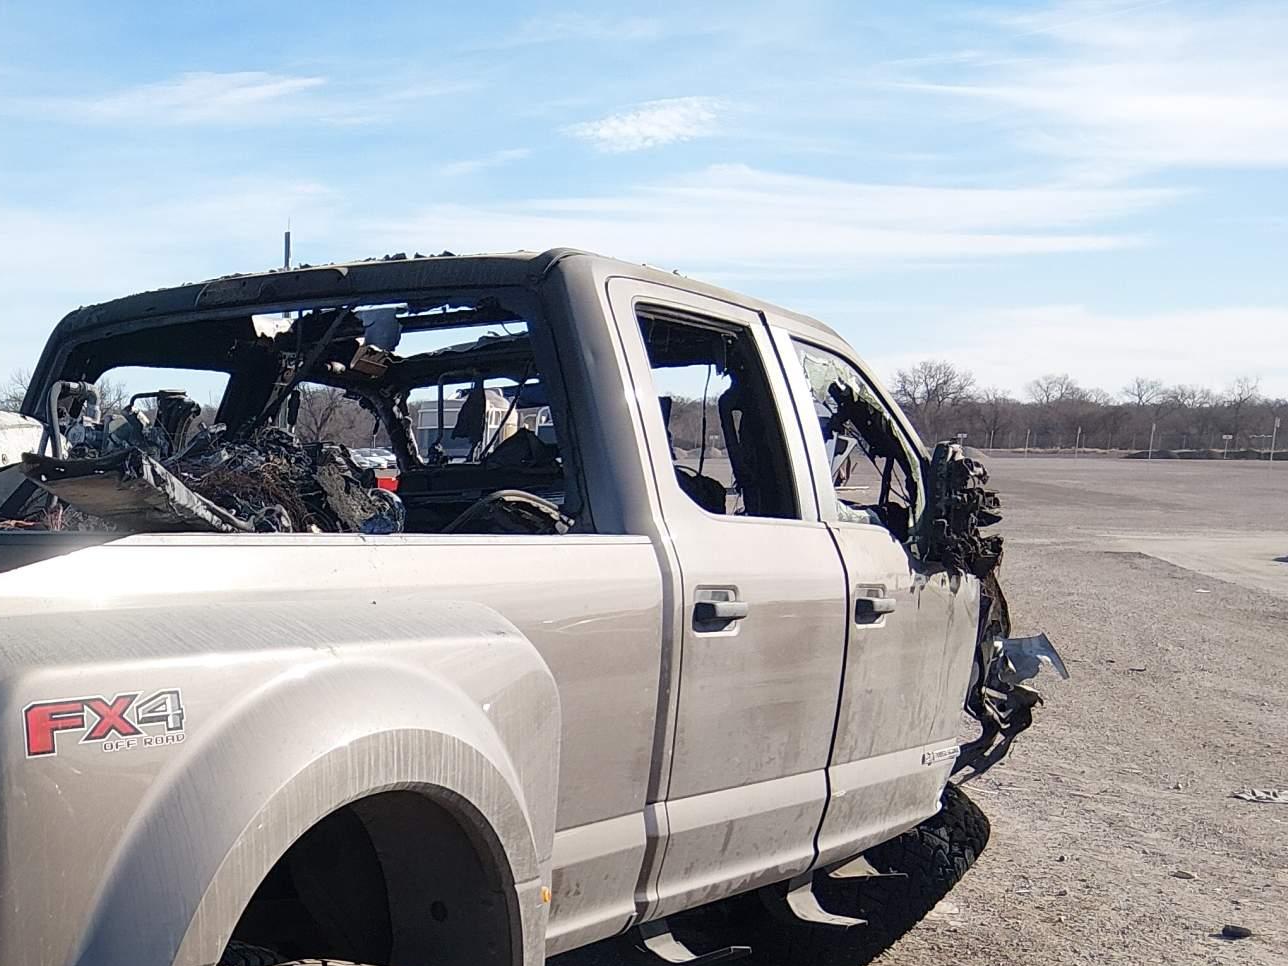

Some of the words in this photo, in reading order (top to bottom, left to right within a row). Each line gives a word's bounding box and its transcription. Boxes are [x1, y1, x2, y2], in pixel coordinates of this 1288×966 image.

[22, 687, 186, 759] FX4
[103, 738, 138, 753] OFF
[143, 732, 186, 748] ROAD
